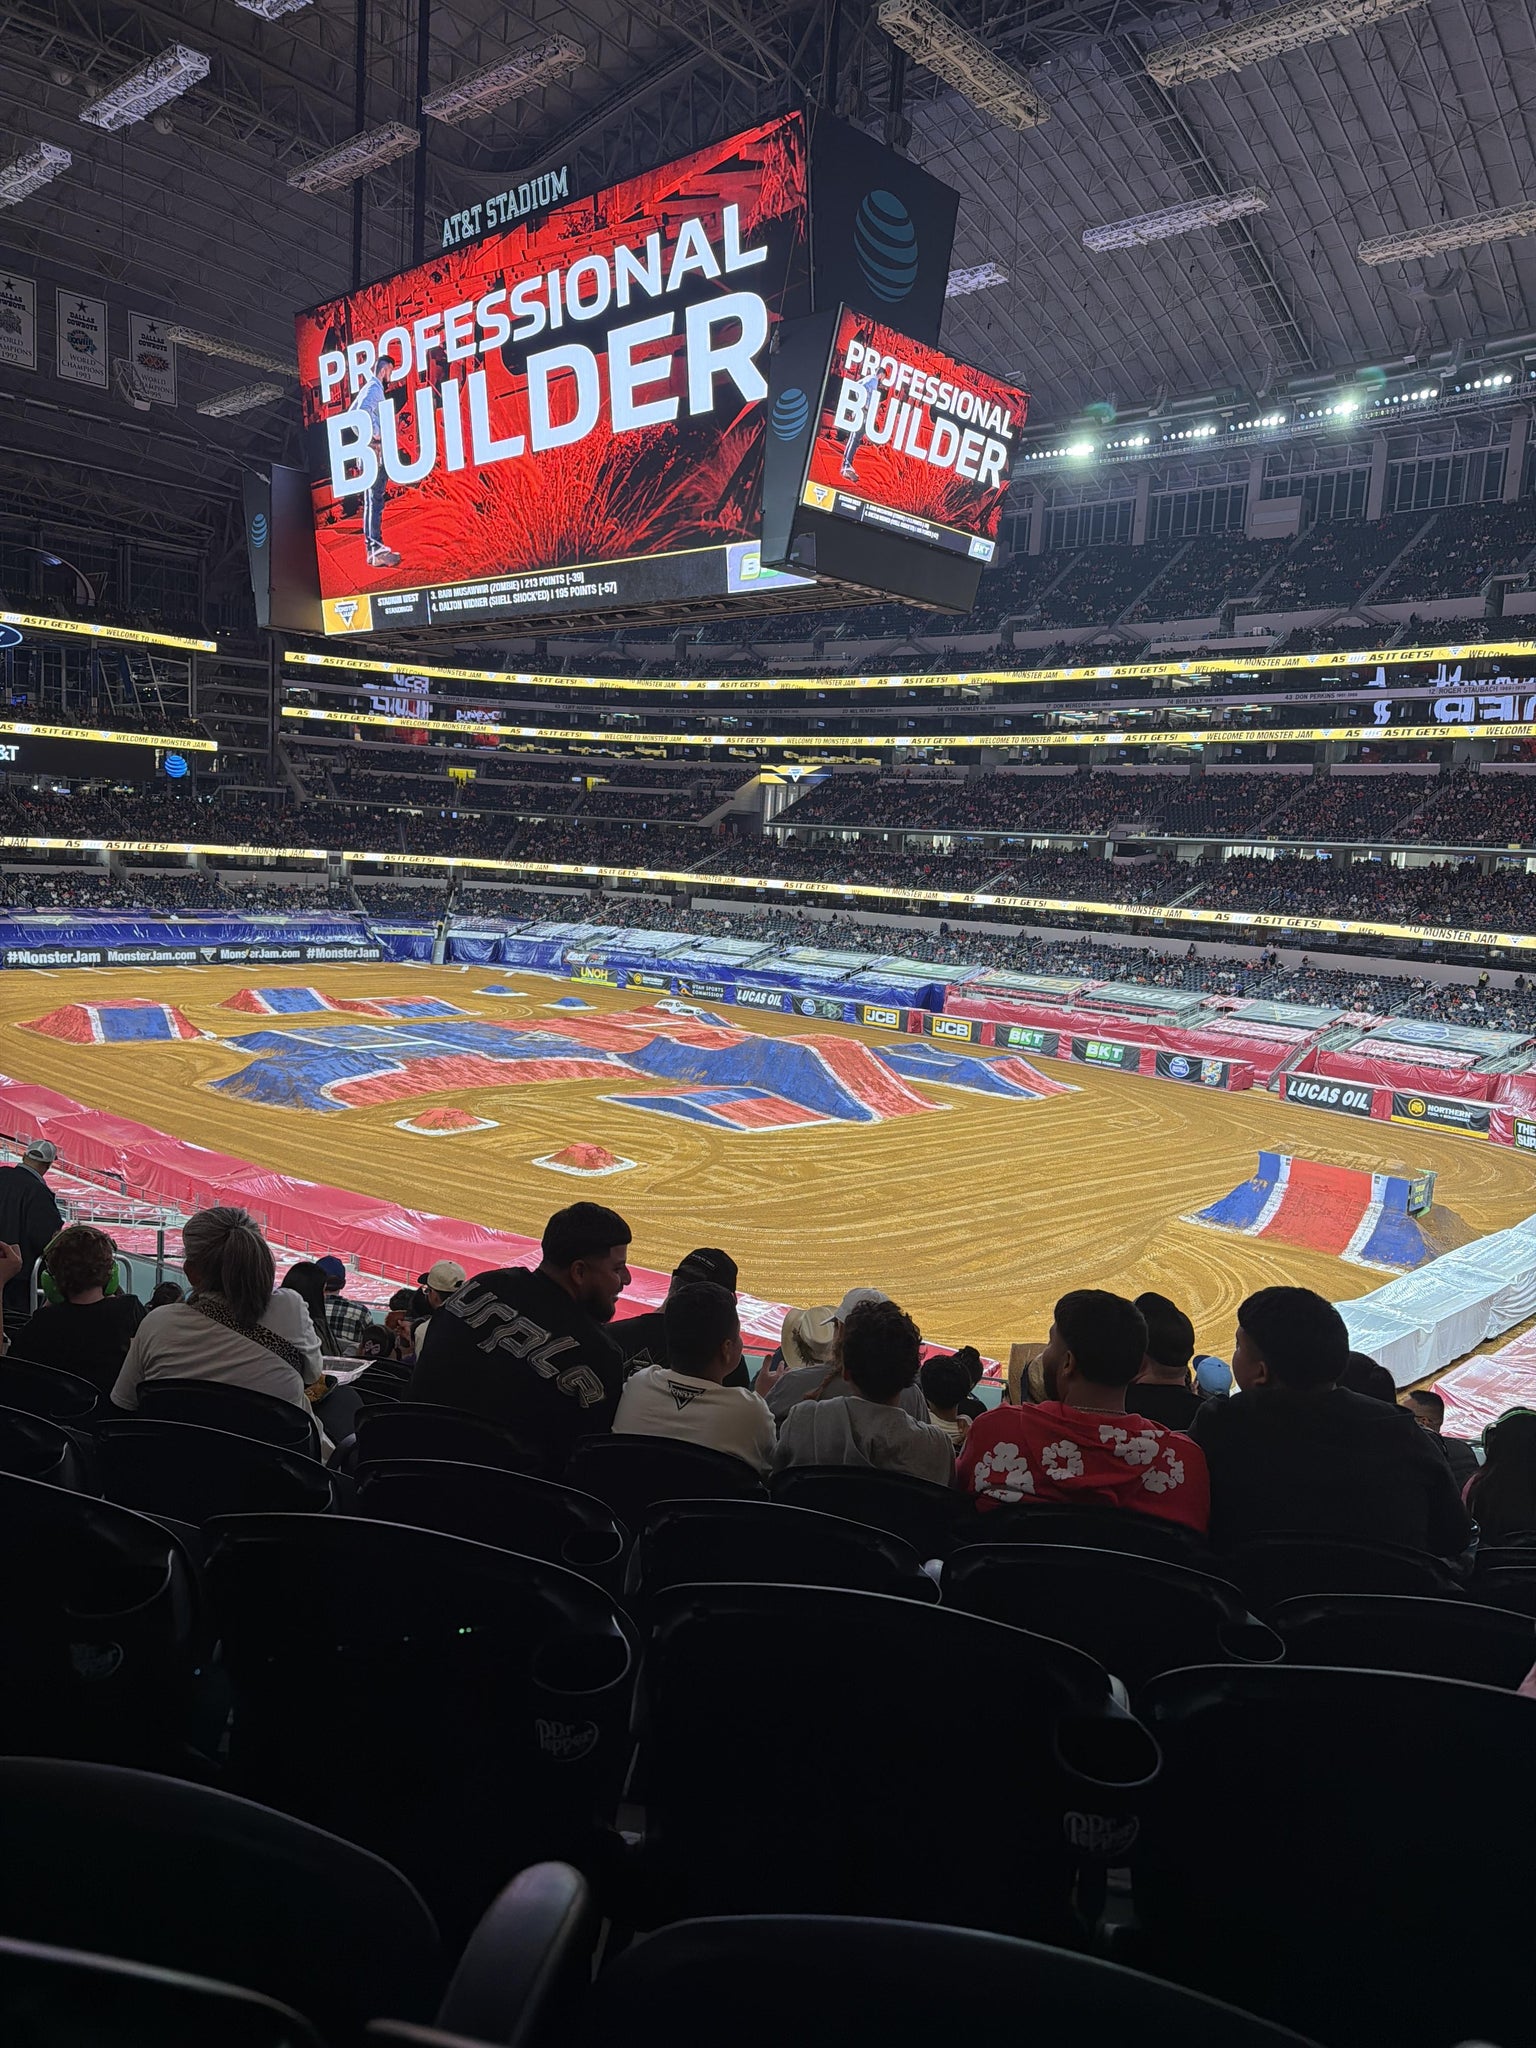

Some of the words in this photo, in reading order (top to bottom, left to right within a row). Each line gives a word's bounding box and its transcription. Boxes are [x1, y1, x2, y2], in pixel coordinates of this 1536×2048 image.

[442, 203, 482, 248] AT&T
[486, 165, 569, 229] STADIUM
[0, 291, 22, 303] ALLAS
[318, 203, 768, 404] PROFESSIONAL
[69, 311, 94, 324] DALLAS
[66, 318, 98, 332] COWBOYS
[138, 340, 168, 352] COWBOYS
[141, 334, 165, 344] DALLAS
[70, 354, 96, 366] WORLD
[62, 360, 104, 376] CHAMPIONS
[75, 370, 91, 380] 1993
[326, 291, 769, 499] BUILDER
[844, 340, 1014, 440] PROFESSIONAL
[834, 376, 1008, 488] BUILDER
[430, 591, 437, 600] 3.
[490, 580, 519, 594] (ZOMBIE)
[525, 578, 538, 588] 213
[539, 574, 564, 586] POINTS
[432, 603, 438, 612] 4.
[439, 600, 462, 611] DALTON
[555, 588, 568, 598] 195
[570, 584, 597, 597] POINTS
[51, 621, 78, 630] GETS!
[106, 629, 139, 640] WELCOME
[1282, 658, 1300, 666] JAM
[1400, 650, 1434, 660] GETS!
[400, 720, 430, 728] WELCOME
[1486, 726, 1533, 735] WELCOME
[61, 729, 89, 738] GETS!
[1206, 732, 1247, 740] WELCOME
[1258, 731, 1294, 740] MONSTER
[1295, 731, 1313, 739] JAM
[1416, 727, 1450, 736] GETS!
[116, 734, 149, 744] WELCOME
[160, 738, 191, 747] MONSTER
[8, 838, 28, 847] JAM
[1215, 913, 1230, 921] AS
[1254, 916, 1270, 924] AS
[1272, 917, 1284, 925] IT
[1287, 918, 1322, 929] GETS!
[1422, 928, 1472, 942] MONSTER
[1474, 934, 1498, 944] JAM
[7, 950, 100, 964] #MonsterJam
[108, 950, 196, 962] MonsterJam.com
[306, 948, 380, 959] #MonsterJam
[580, 966, 608, 980] UNOH
[737, 989, 766, 1003] LUCAS
[768, 994, 782, 1006] OIL
[866, 1010, 896, 1025] JCB
[936, 1020, 969, 1036] JCB
[1009, 1029, 1044, 1046] BKT
[1086, 1043, 1123, 1059] BKT
[1288, 1080, 1340, 1104] LUCAS
[1342, 1088, 1368, 1110] OIL
[1427, 1104, 1471, 1118] NORTHERN
[1517, 1123, 1536, 1136] THE
[536, 1718, 594, 1756] Pepper
[1064, 1812, 1135, 1852] Pepper
